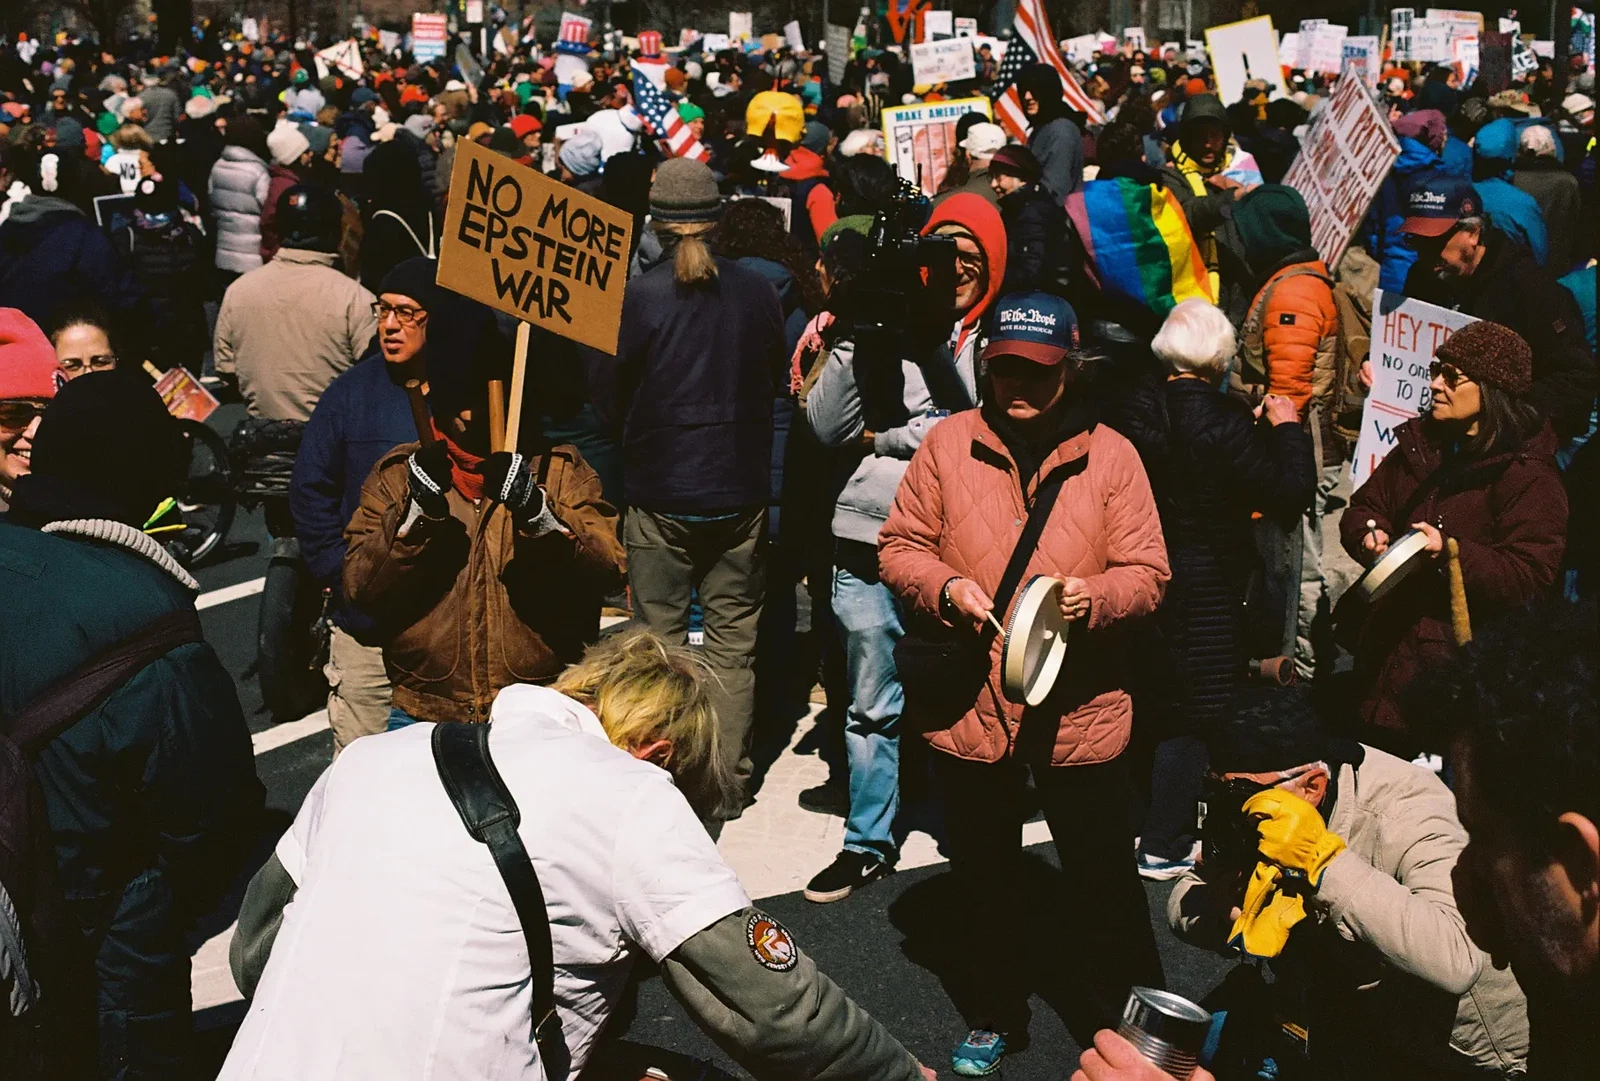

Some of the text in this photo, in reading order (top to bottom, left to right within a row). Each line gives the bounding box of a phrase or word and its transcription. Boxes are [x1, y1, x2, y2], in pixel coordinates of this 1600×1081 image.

[896, 110, 922, 122] MAKE
[466, 158, 626, 260] NO MORE
[458, 202, 612, 291] EPSTEIN
[491, 258, 572, 324] WAR
[1000, 308, 1056, 326] We the People
[1028, 325, 1053, 335] ENOUGH
[1383, 310, 1422, 352] HEY
[1382, 353, 1404, 370] NO
[1396, 379, 1412, 400] TO
